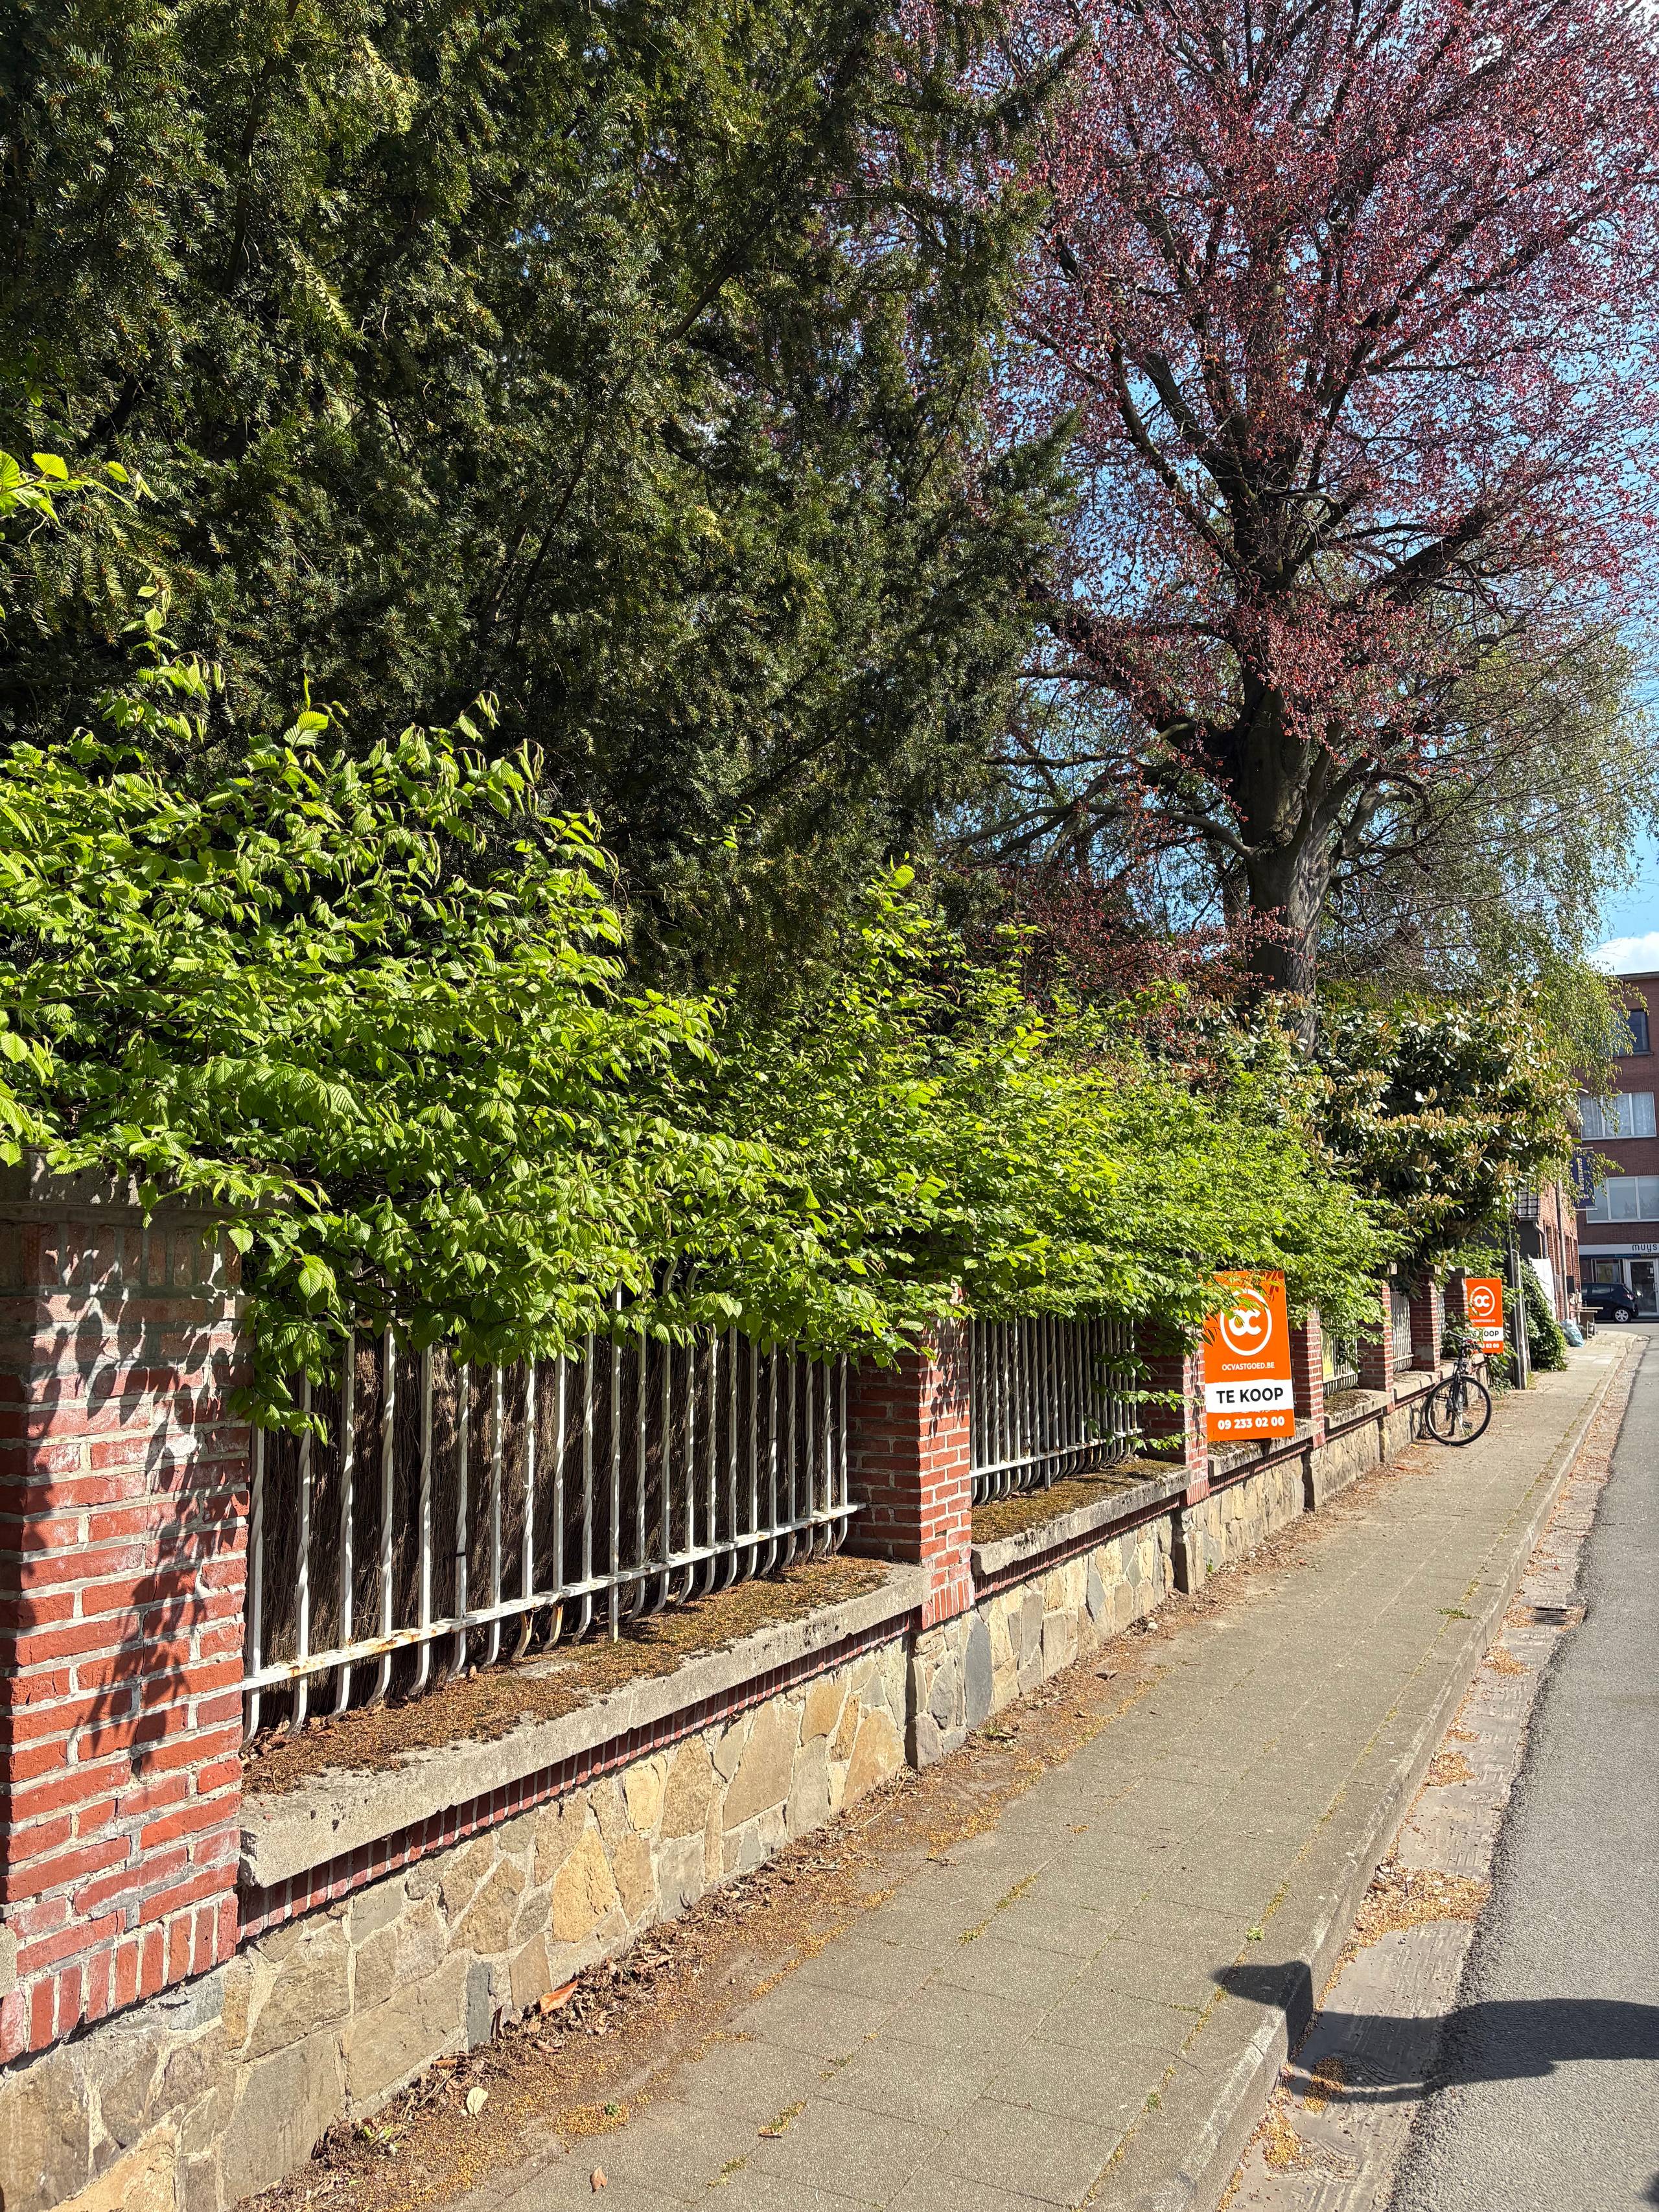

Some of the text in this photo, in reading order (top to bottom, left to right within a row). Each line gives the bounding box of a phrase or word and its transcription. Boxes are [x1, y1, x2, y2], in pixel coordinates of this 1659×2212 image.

[1632, 1244, 1657, 1253] muys
[1222, 1362, 1275, 1371] OCVASTGOED.BE
[1216, 1388, 1283, 1404] TE KOOP
[1218, 1415, 1284, 1430] 09 233 02 00
